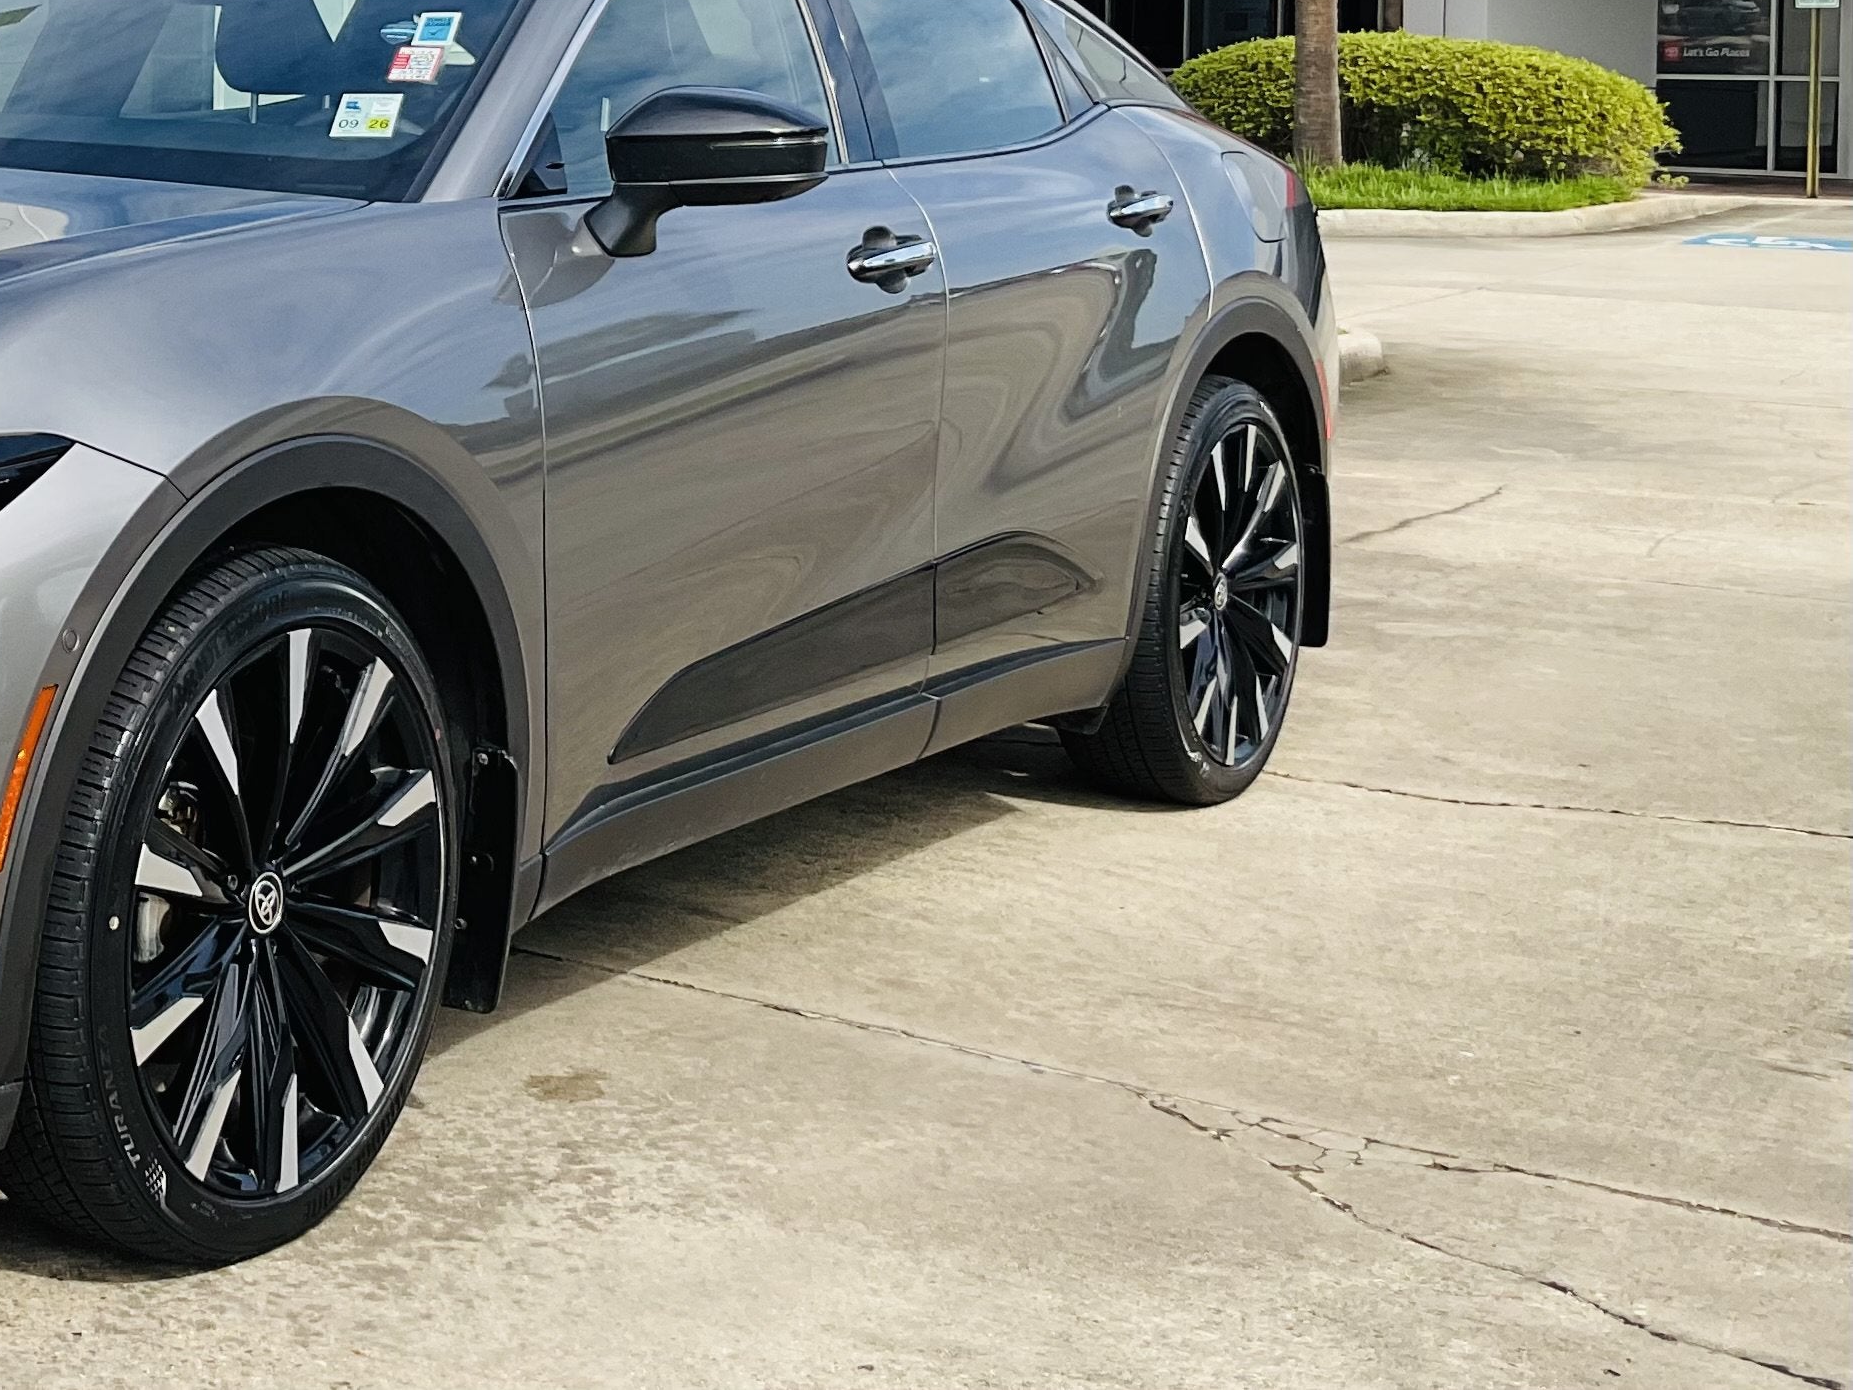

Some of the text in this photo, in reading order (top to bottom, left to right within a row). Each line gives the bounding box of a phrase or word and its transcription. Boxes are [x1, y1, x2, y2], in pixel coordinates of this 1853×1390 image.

[1706, 47, 1719, 58] Go
[338, 118, 390, 129] 09 26
